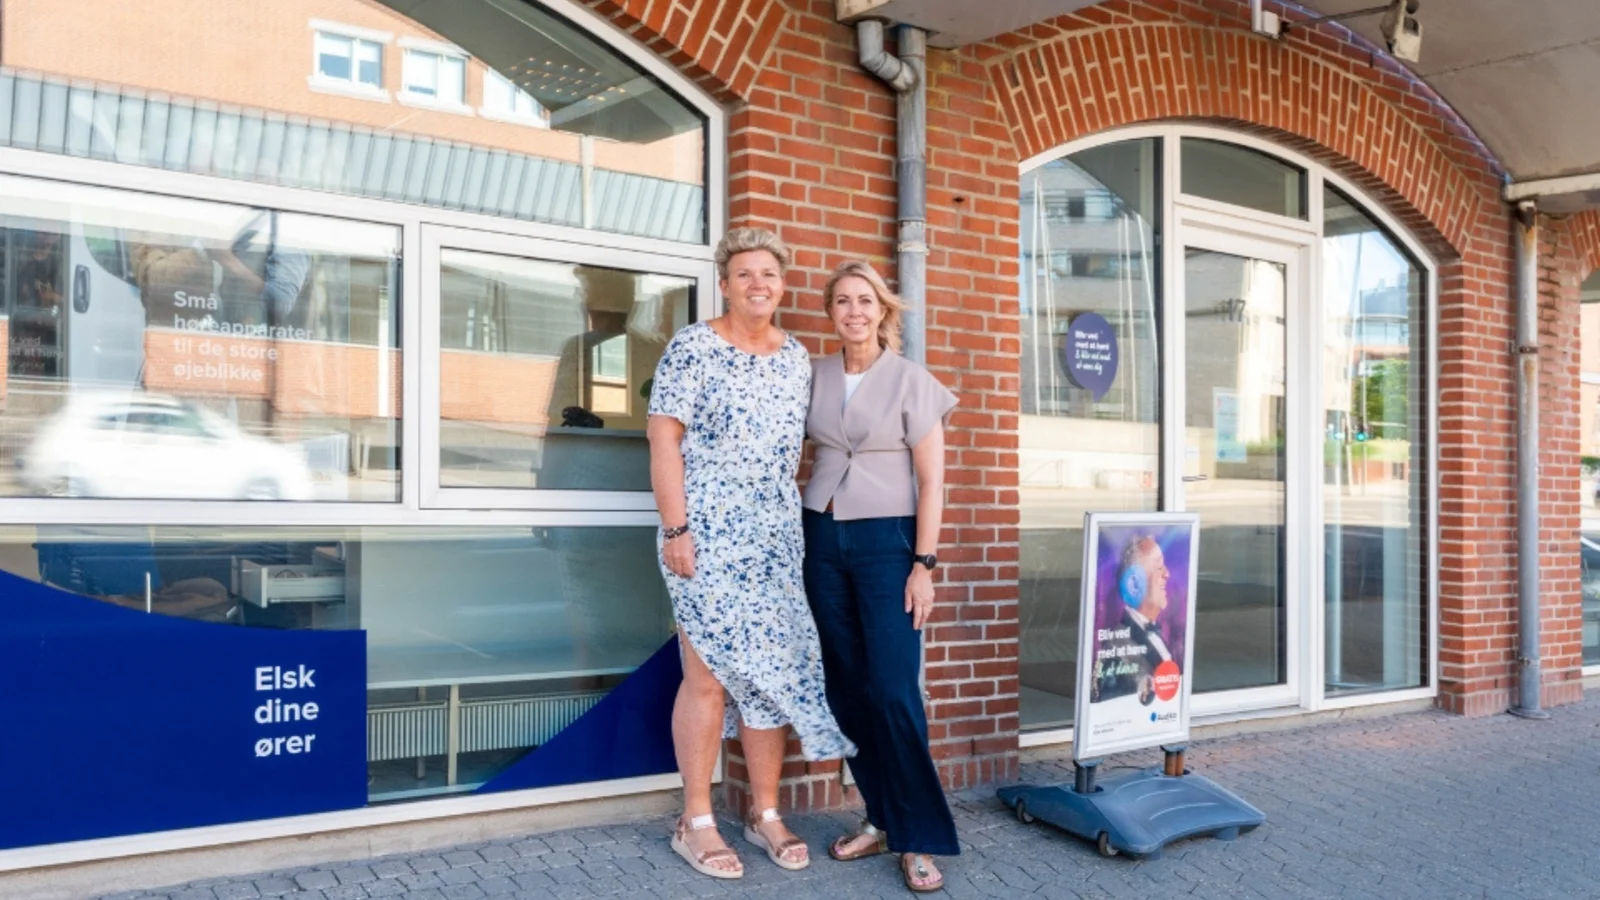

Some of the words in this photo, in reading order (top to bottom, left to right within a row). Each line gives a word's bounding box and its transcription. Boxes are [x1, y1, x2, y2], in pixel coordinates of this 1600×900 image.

[173, 291, 218, 310] Små
[174, 314, 313, 341] høreapparater
[173, 337, 192, 354] til
[198, 339, 224, 356] de
[229, 343, 278, 360] store
[173, 360, 263, 381] øjeblikke
[1098, 628, 1114, 641] Bliv
[1114, 626, 1131, 639] ved
[1097, 645, 1116, 659] med
[1116, 644, 1126, 656] at
[255, 664, 316, 691] Elsk
[254, 698, 320, 724] dine
[254, 734, 316, 757] ører
